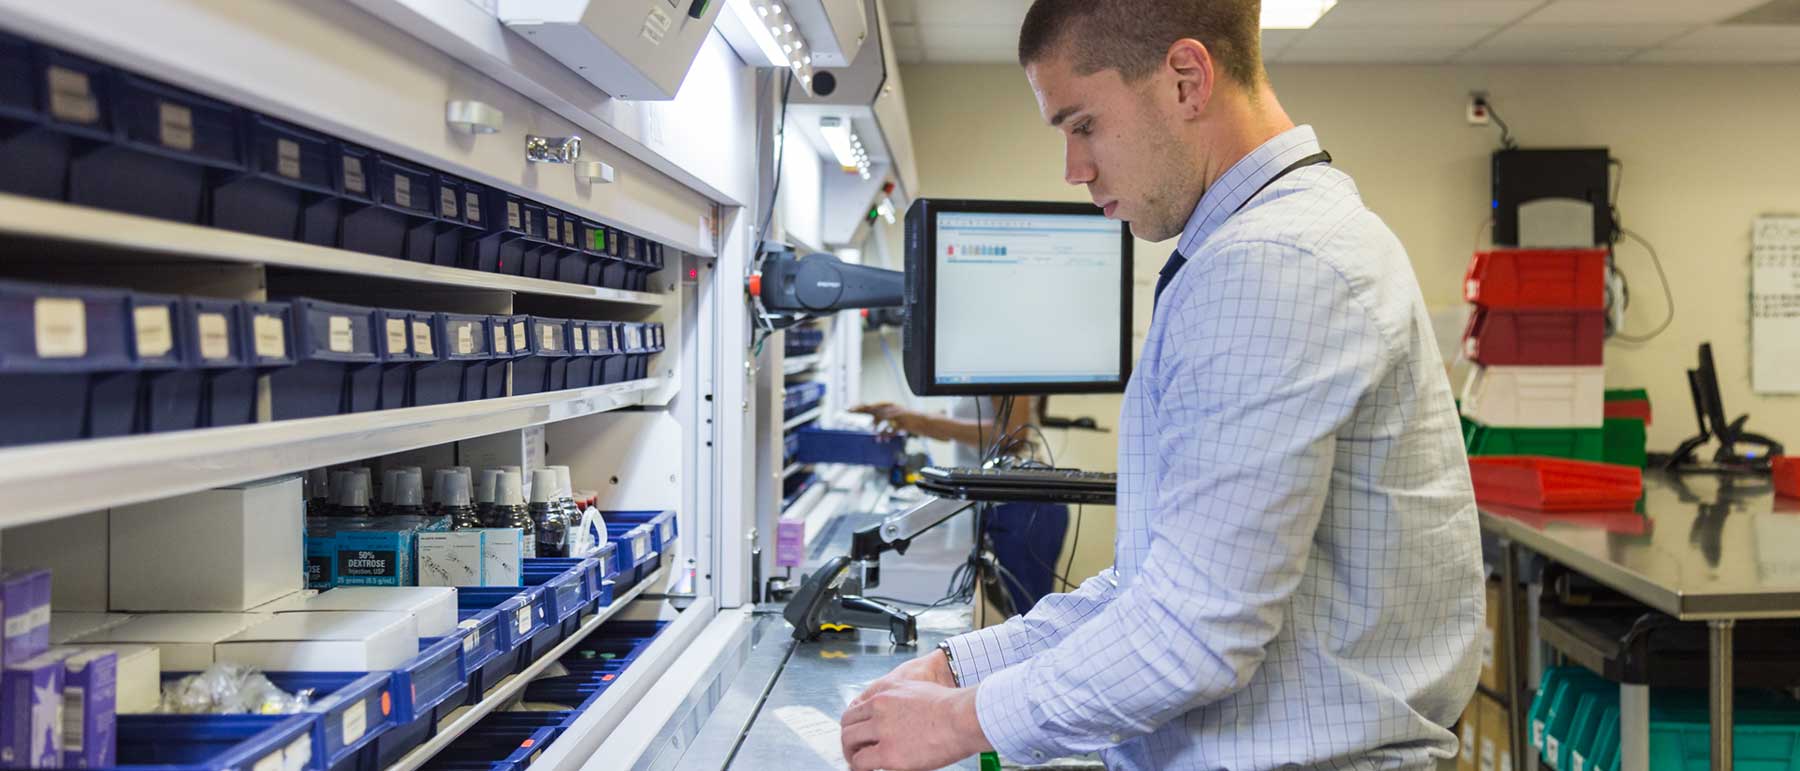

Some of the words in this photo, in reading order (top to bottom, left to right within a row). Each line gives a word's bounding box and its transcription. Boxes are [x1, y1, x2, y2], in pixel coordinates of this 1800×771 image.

[358, 551, 375, 559] 50%
[348, 559, 386, 568] DEXTROSE
[345, 577, 364, 585] grams
